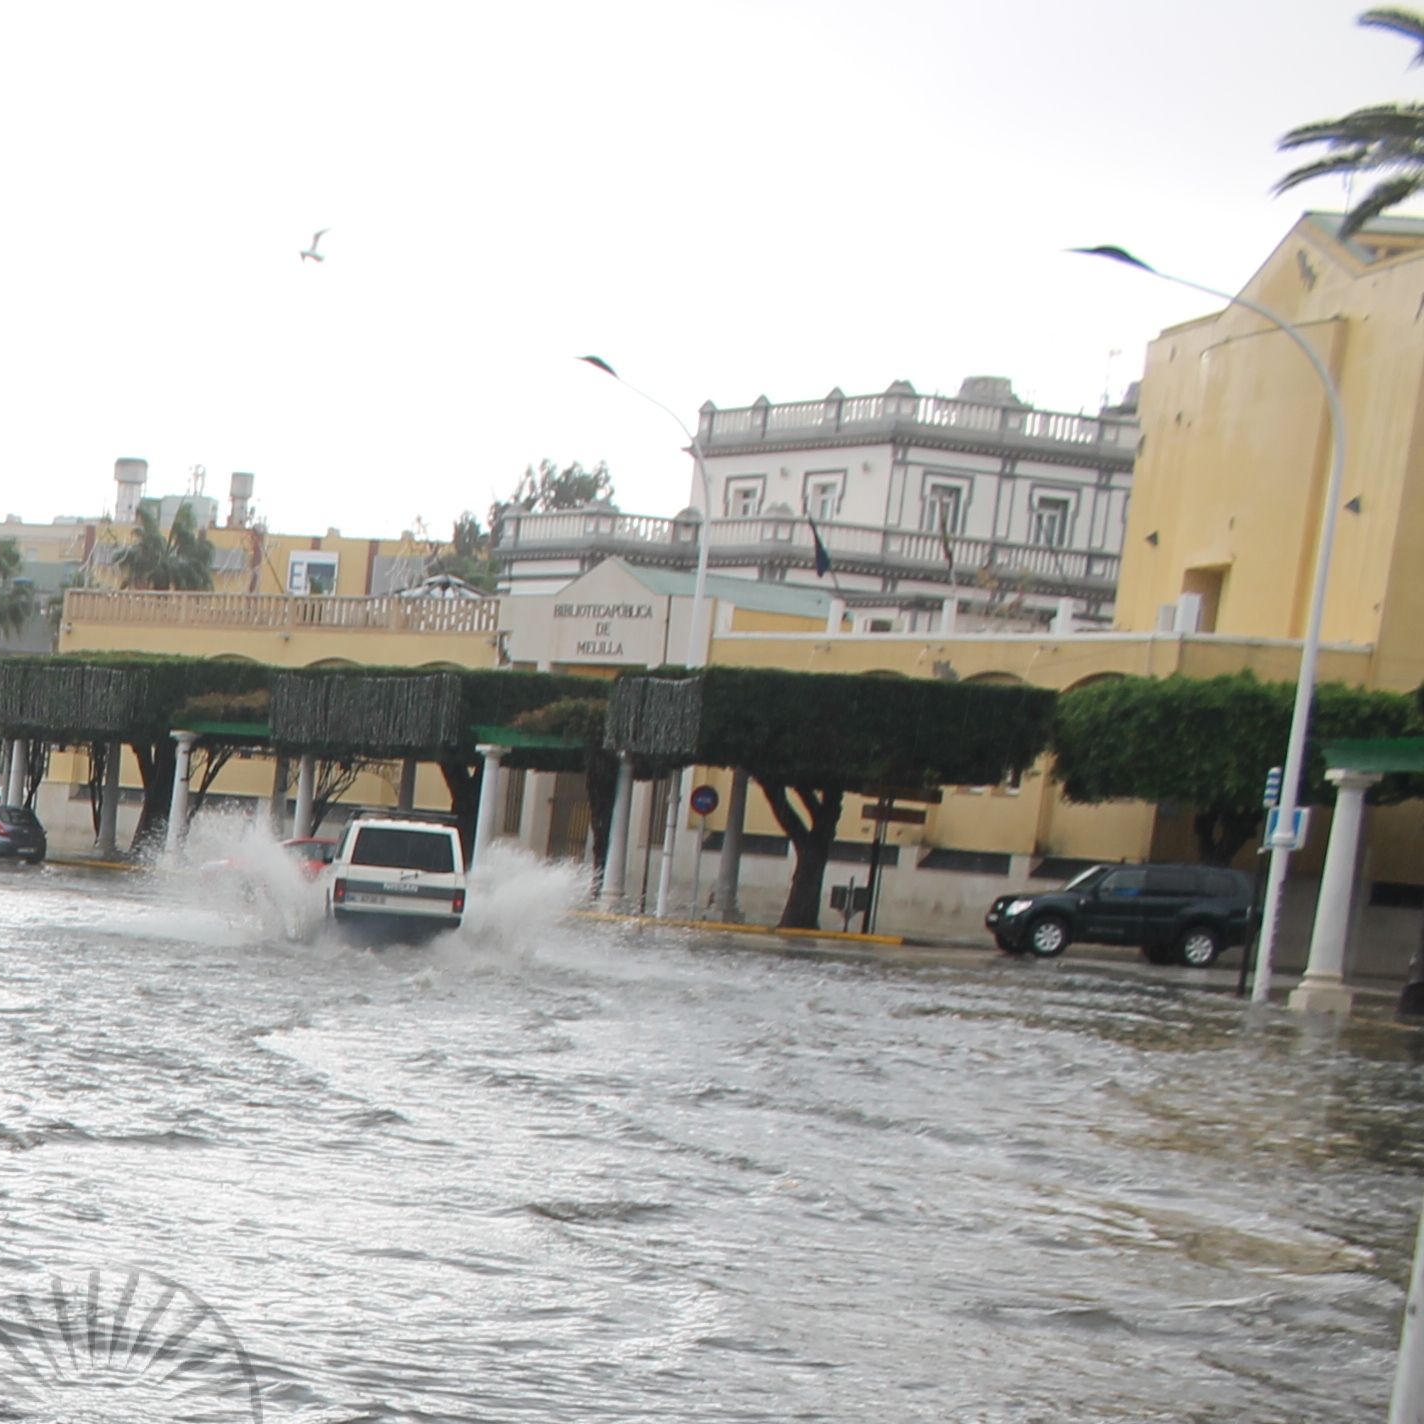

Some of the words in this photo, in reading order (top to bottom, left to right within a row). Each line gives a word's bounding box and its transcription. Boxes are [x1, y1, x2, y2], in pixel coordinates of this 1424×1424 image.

[554, 604, 612, 618] BIBLIOTECA
[596, 621, 611, 636] DE
[577, 640, 623, 655] MELILLA
